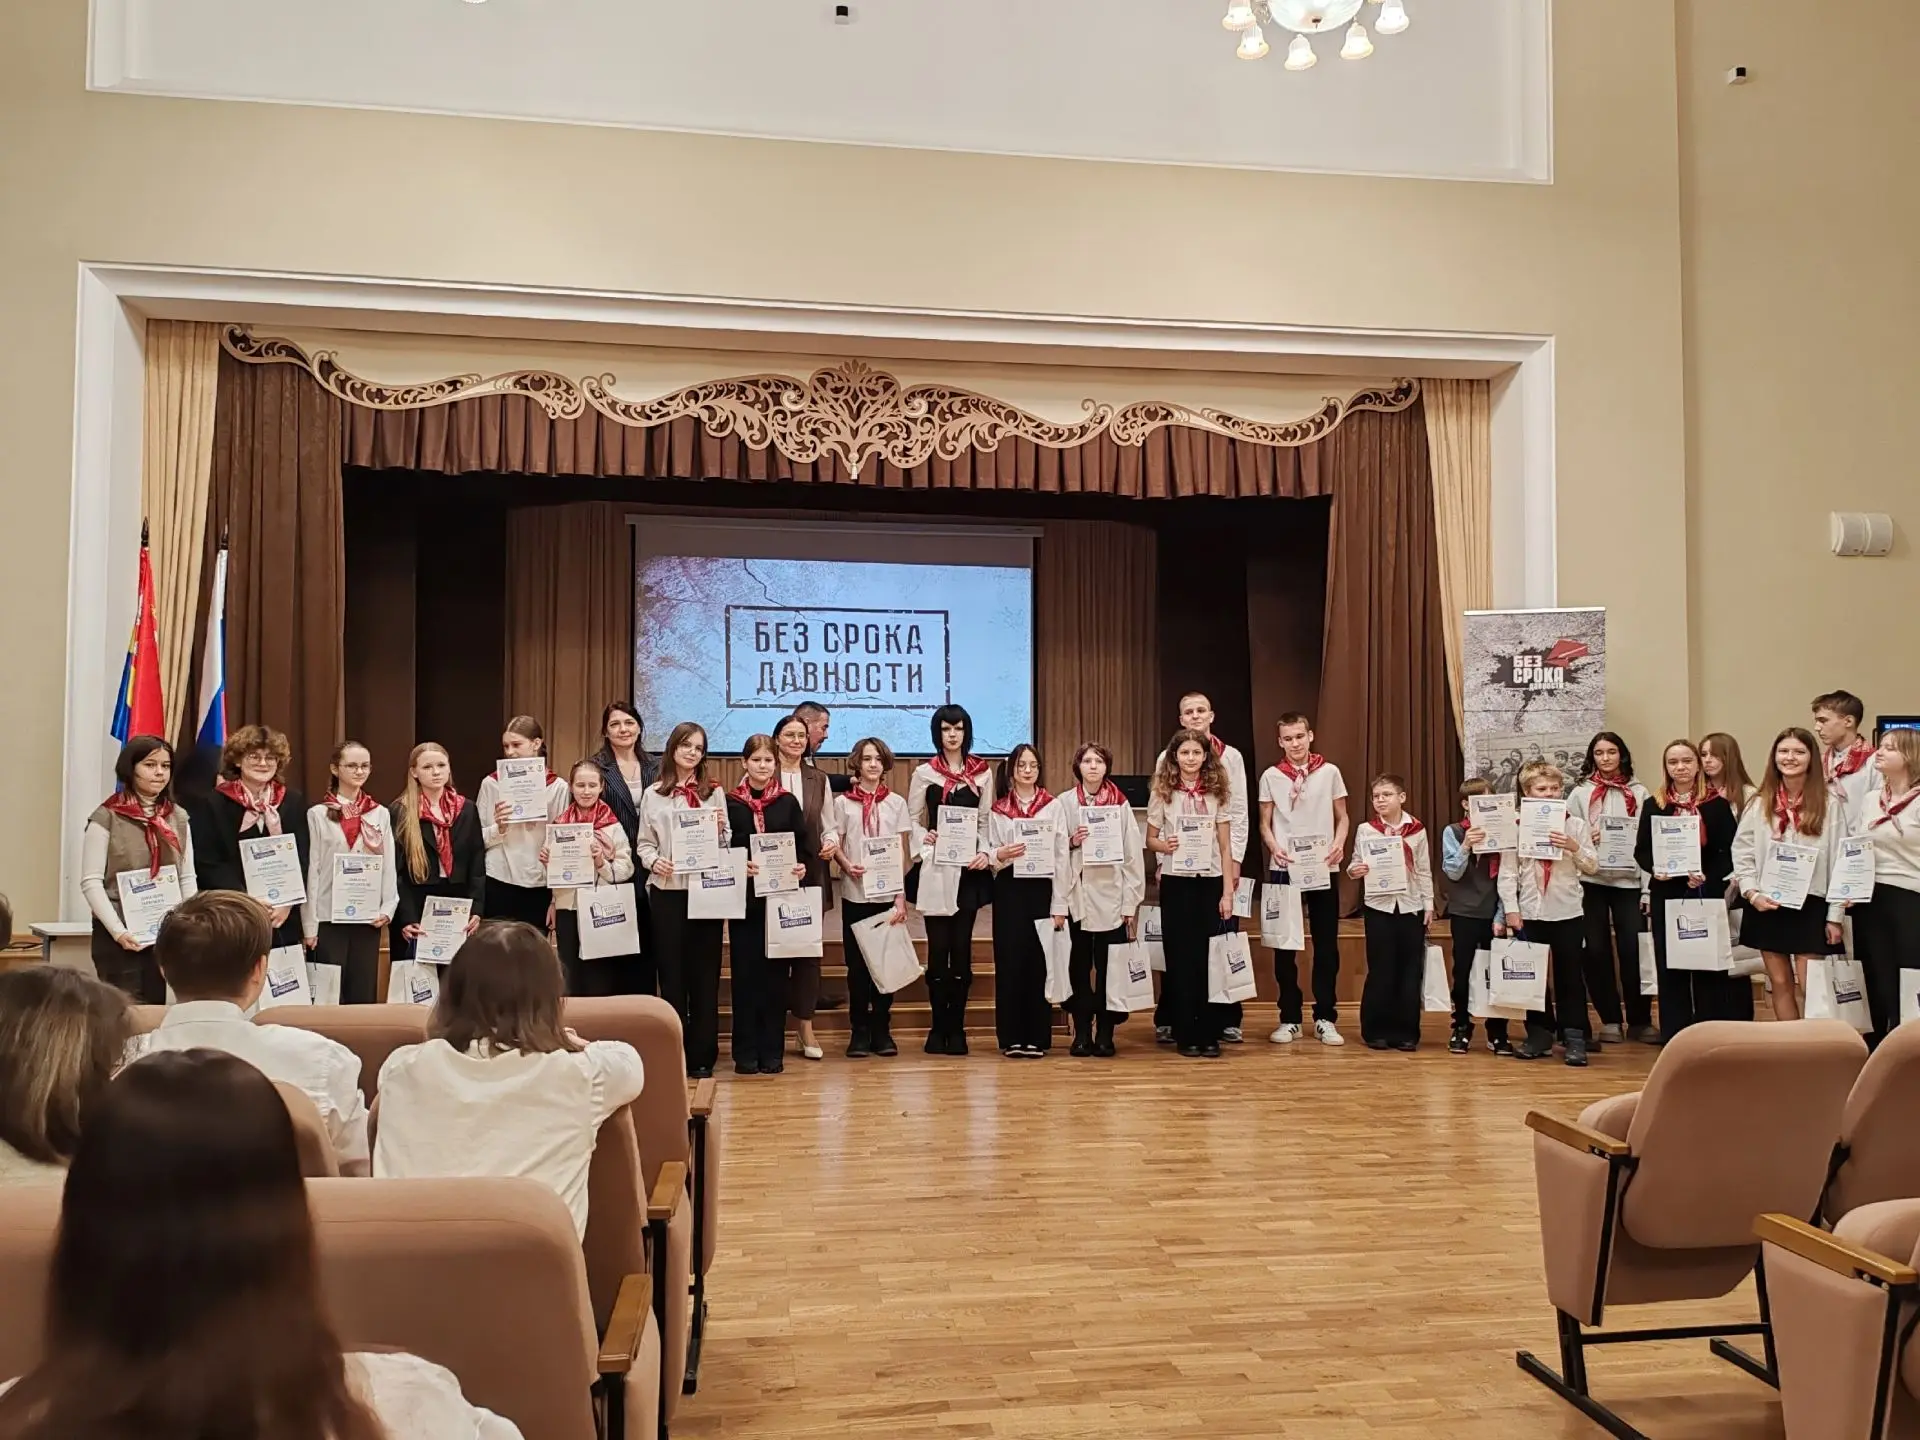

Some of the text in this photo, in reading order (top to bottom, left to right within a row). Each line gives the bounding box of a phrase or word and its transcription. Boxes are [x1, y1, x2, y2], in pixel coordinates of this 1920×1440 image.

[755, 621, 924, 655] БЕЗ СРОКА
[1513, 655, 1542, 667] БЕЗ
[756, 661, 923, 696] ДАВНОСТИ
[1513, 667, 1564, 684] СРОКА
